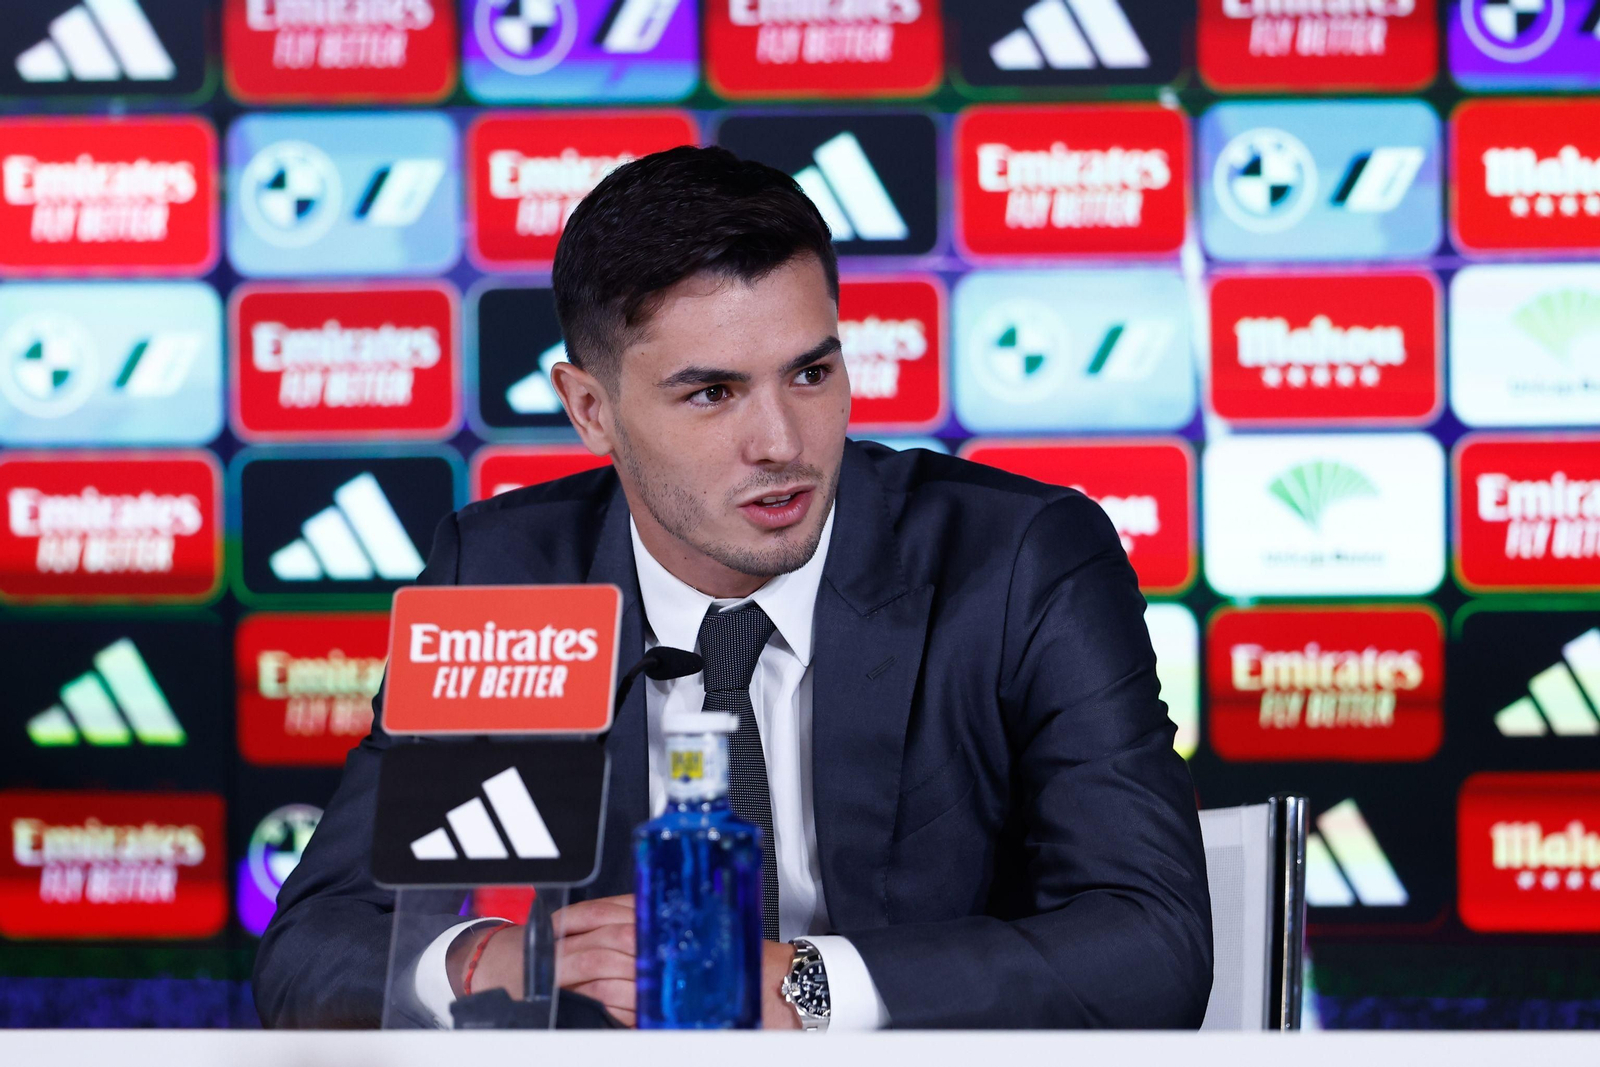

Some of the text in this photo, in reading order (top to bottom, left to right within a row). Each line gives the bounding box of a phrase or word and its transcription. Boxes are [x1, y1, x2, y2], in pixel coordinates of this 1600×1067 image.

[1483, 145, 1600, 197] Mah
[1475, 471, 1600, 521] Emira
[410, 621, 598, 663] Emirates
[1231, 642, 1423, 691] Emirates
[432, 665, 568, 698] FLY BETTER
[1490, 820, 1600, 869] Mah
